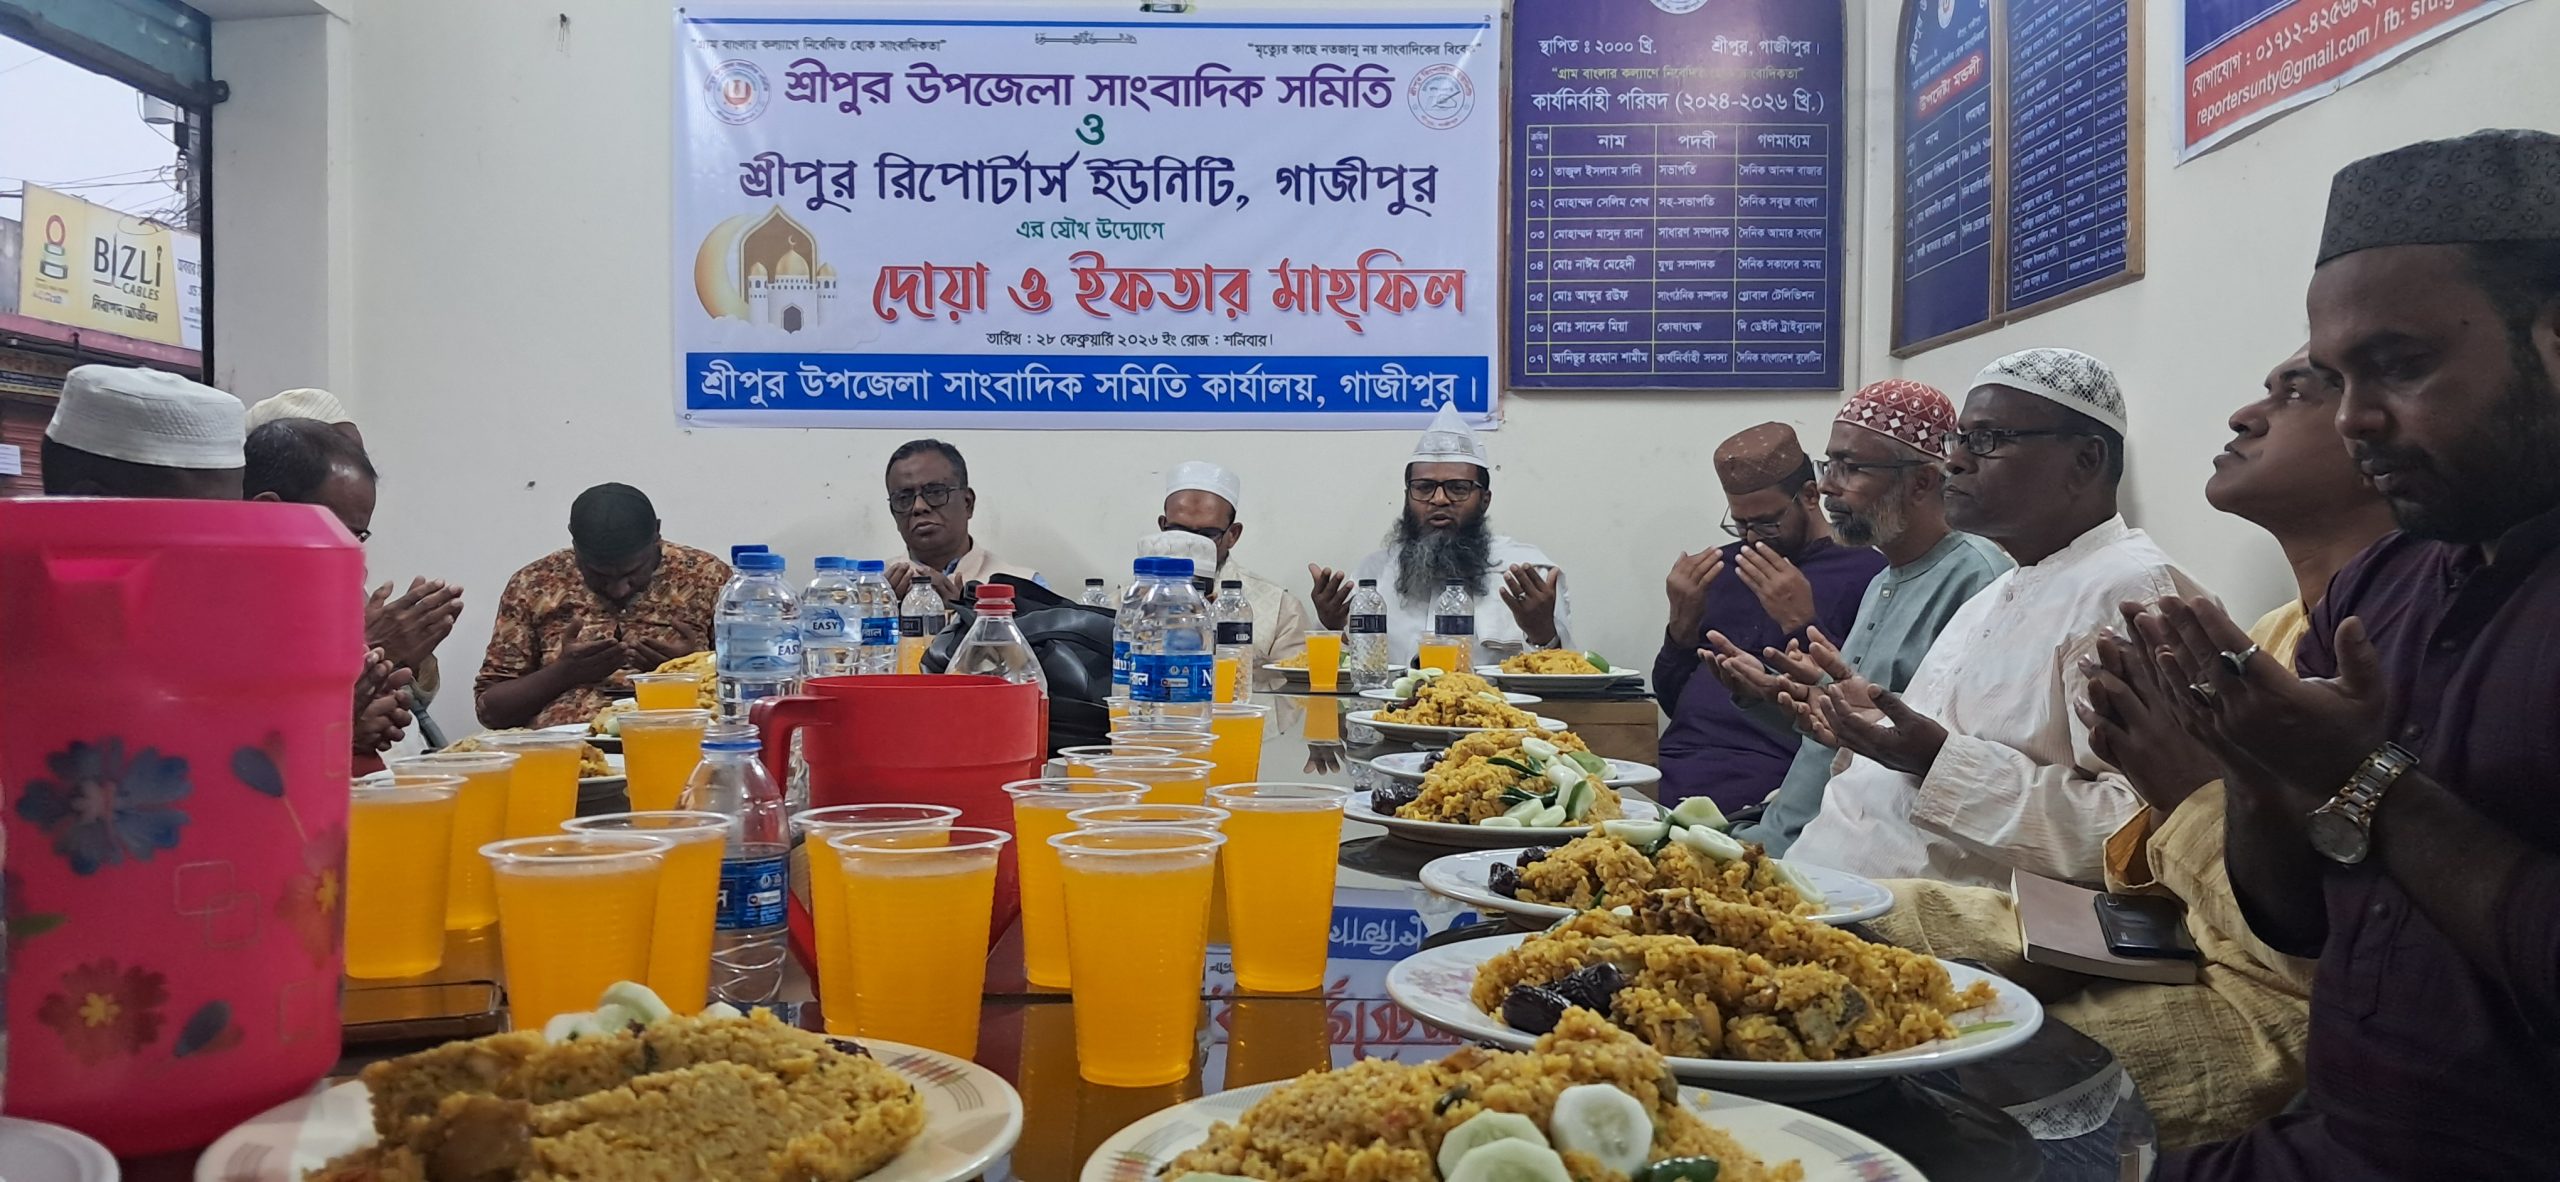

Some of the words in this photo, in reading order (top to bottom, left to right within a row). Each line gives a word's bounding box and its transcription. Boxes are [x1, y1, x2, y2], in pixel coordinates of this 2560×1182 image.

[851, 39, 876, 52] হোক
[1292, 43, 1318, 56] কাছে
[1321, 44, 1359, 58] নতজানু
[1362, 44, 1377, 55] নয়
[1381, 41, 1440, 56] সাংবাদিকের
[1538, 36, 1579, 56] স্থাপিত
[1595, 41, 1633, 54] ২০০০
[1711, 35, 1753, 57] শ্রীপুর,
[1758, 36, 1811, 57] গাজীপুর
[1583, 68, 1617, 79] বাংলার
[1622, 68, 1658, 80] কল্যাণে
[2192, 51, 2242, 97] যোগাযোগ
[2196, 27, 2369, 127] reportersunty@gmail.com
[2384, 7, 2405, 34] fb:
[785, 57, 893, 115] শ্রীপুর
[905, 62, 1074, 106] উপজেলা
[1086, 62, 1265, 112] সাংবাদিক
[1277, 62, 1395, 108] সমিতি
[1531, 87, 1612, 112] কার্যনির্বাহী
[1617, 88, 1669, 111] পরিষদ
[1675, 90, 1788, 114] (২০২৪-২০২৬
[1075, 113, 1105, 145] ও
[1597, 134, 1627, 149] নাম
[1678, 130, 1718, 149] পদবী
[1757, 133, 1811, 149] গণমাধ্যম
[1530, 168, 1544, 178] ০১
[1553, 166, 1582, 179] তাজুল
[1585, 164, 1618, 177] ইসলাম
[1620, 163, 1642, 177] সানি
[1658, 161, 1697, 176] সভাপতি
[1738, 163, 1765, 176] দৈনিক
[1797, 165, 1823, 175] বাজার
[739, 151, 858, 212] শ্রীপুর
[874, 150, 1081, 203] রিপোর্টার্স
[1083, 155, 1250, 211] ইউনিটি,
[1276, 156, 1438, 217] গাজীপুর
[1530, 199, 1545, 209] ০২
[1553, 197, 1593, 208] মোহাম্মদ
[1596, 194, 1627, 207] সেলিম
[1630, 197, 1649, 207] শেখ
[1658, 194, 1716, 208] সহ-সভাপতি
[1738, 193, 1766, 208] দৈনিক
[1769, 197, 1792, 209] সবুজ
[1794, 197, 1819, 208] বাংলা
[1016, 221, 1045, 239] এর
[1050, 216, 1091, 240] যৌথ
[1095, 217, 1165, 241] উদ্যোগে
[1530, 230, 1545, 239] ০৩
[1553, 229, 1593, 240] মোহাম্মদ
[1596, 229, 1621, 241] মাসুদ
[1624, 228, 1643, 239] রানা
[1657, 227, 1690, 239] সাধারণ
[1693, 227, 1730, 239] সম্পাদক
[1738, 225, 1765, 239] দৈনিক
[1768, 227, 1794, 238] আমার
[1796, 227, 1823, 239] সংবাদ
[1529, 261, 1544, 270] ০৪
[1553, 259, 1572, 270] মোঃ
[1575, 257, 1600, 270] নাঈম
[1603, 255, 1636, 271] মেহেদী
[1677, 260, 1716, 270] সম্পাদক
[1738, 257, 1764, 270] দৈনিক
[1767, 259, 1800, 270] সকালের
[1802, 259, 1822, 270] সময়
[122, 282, 160, 301] CABLES
[872, 260, 990, 325] দোয়া
[1008, 266, 1054, 313] ও
[1068, 250, 1251, 321] ইফতার
[1771, 288, 1815, 300] টেলিভিশন
[1529, 292, 1544, 302] ০৫
[1552, 290, 1572, 301] মোঃ
[1697, 290, 1728, 300] সম্পাদক
[1529, 324, 1544, 332] ০৬
[1552, 321, 1572, 332] মোঃ
[1575, 321, 1605, 332] সাদেক
[1608, 318, 1628, 332] মিয়া
[1657, 321, 1702, 332] কোষাধ্যক্ষ
[1750, 319, 1778, 332] ডেইলি
[986, 332, 1022, 346] তারিখ
[1036, 334, 1055, 345] ২৮
[1060, 331, 1114, 348] ফেব্রুয়ারি
[1118, 334, 1158, 346] ২০২৬
[1162, 332, 1177, 346] ইং
[1181, 334, 1208, 346] রোজ
[1529, 354, 1544, 363] ০৭
[1588, 352, 1618, 364] রহমান
[1620, 348, 1648, 363] শামীম
[1703, 353, 1728, 363] সদস্য
[1736, 351, 1760, 364] দৈনিক
[700, 359, 788, 407] শ্রীপুর
[797, 361, 933, 401] উপজেলা
[943, 362, 1084, 404] সাংবাদিক
[1092, 362, 1191, 402] সমিতি
[1198, 362, 1326, 408] কার্যালয়,
[1340, 363, 1458, 409] গাজীপুর
[812, 621, 838, 631] EASY
